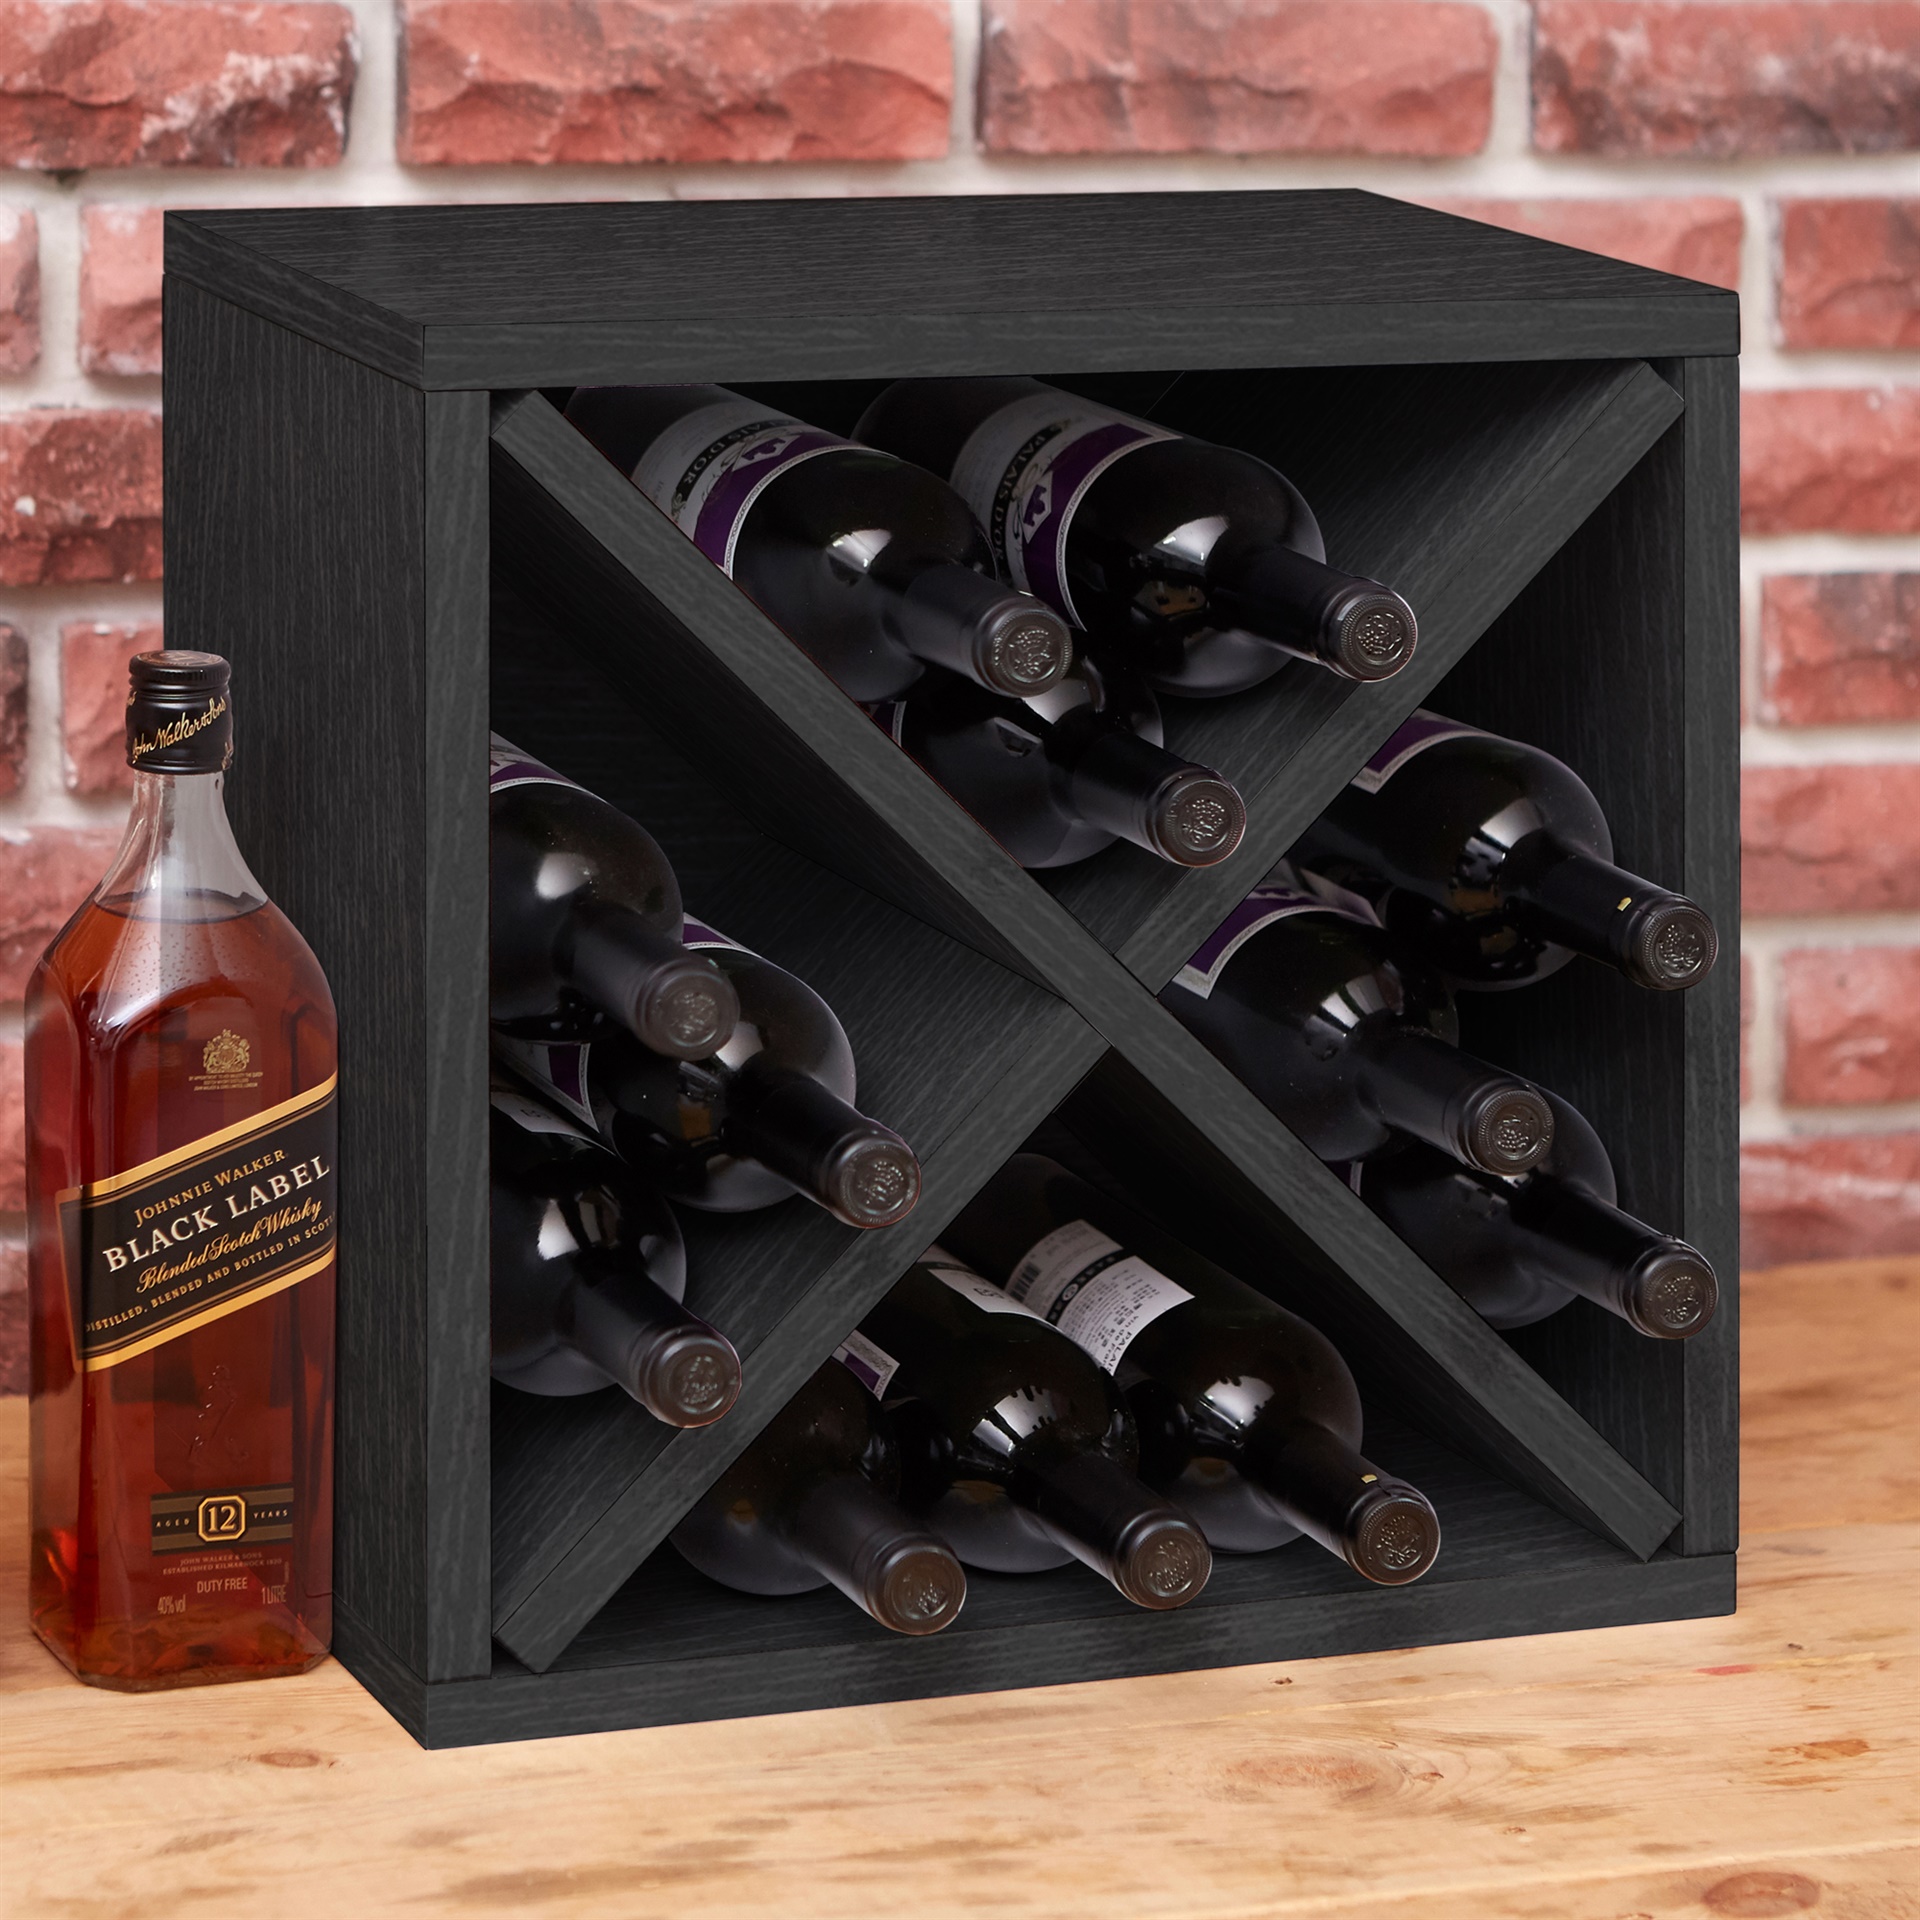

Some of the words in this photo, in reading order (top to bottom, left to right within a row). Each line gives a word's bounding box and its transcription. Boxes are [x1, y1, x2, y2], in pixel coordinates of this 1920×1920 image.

[684, 440, 726, 485] D'OR
[998, 435, 1046, 501] PALAIS
[155, 711, 202, 750] Walker
[134, 1181, 213, 1228] JOHNNIE
[214, 1149, 286, 1188] WALKER
[102, 1205, 219, 1272] BLACK
[225, 1155, 330, 1218] LABEL
[136, 1243, 210, 1293] Blended
[207, 1219, 262, 1260] Scotch
[259, 1196, 322, 1237] Whisky
[150, 1279, 203, 1308] BLENDED
[206, 1265, 231, 1284] AND
[234, 1242, 284, 1272] BOTTLED
[287, 1234, 301, 1247] IN
[155, 1517, 191, 1528] AGED
[207, 1504, 238, 1533] 12
[253, 1509, 288, 1519] YEARS
[163, 1564, 214, 1575] ESTABLISHED
[180, 1558, 200, 1567] JOHN
[203, 1555, 231, 1564] WALKER
[242, 1552, 262, 1560] SONS
[196, 1579, 223, 1594] DUTY
[224, 1577, 248, 1591] FREE
